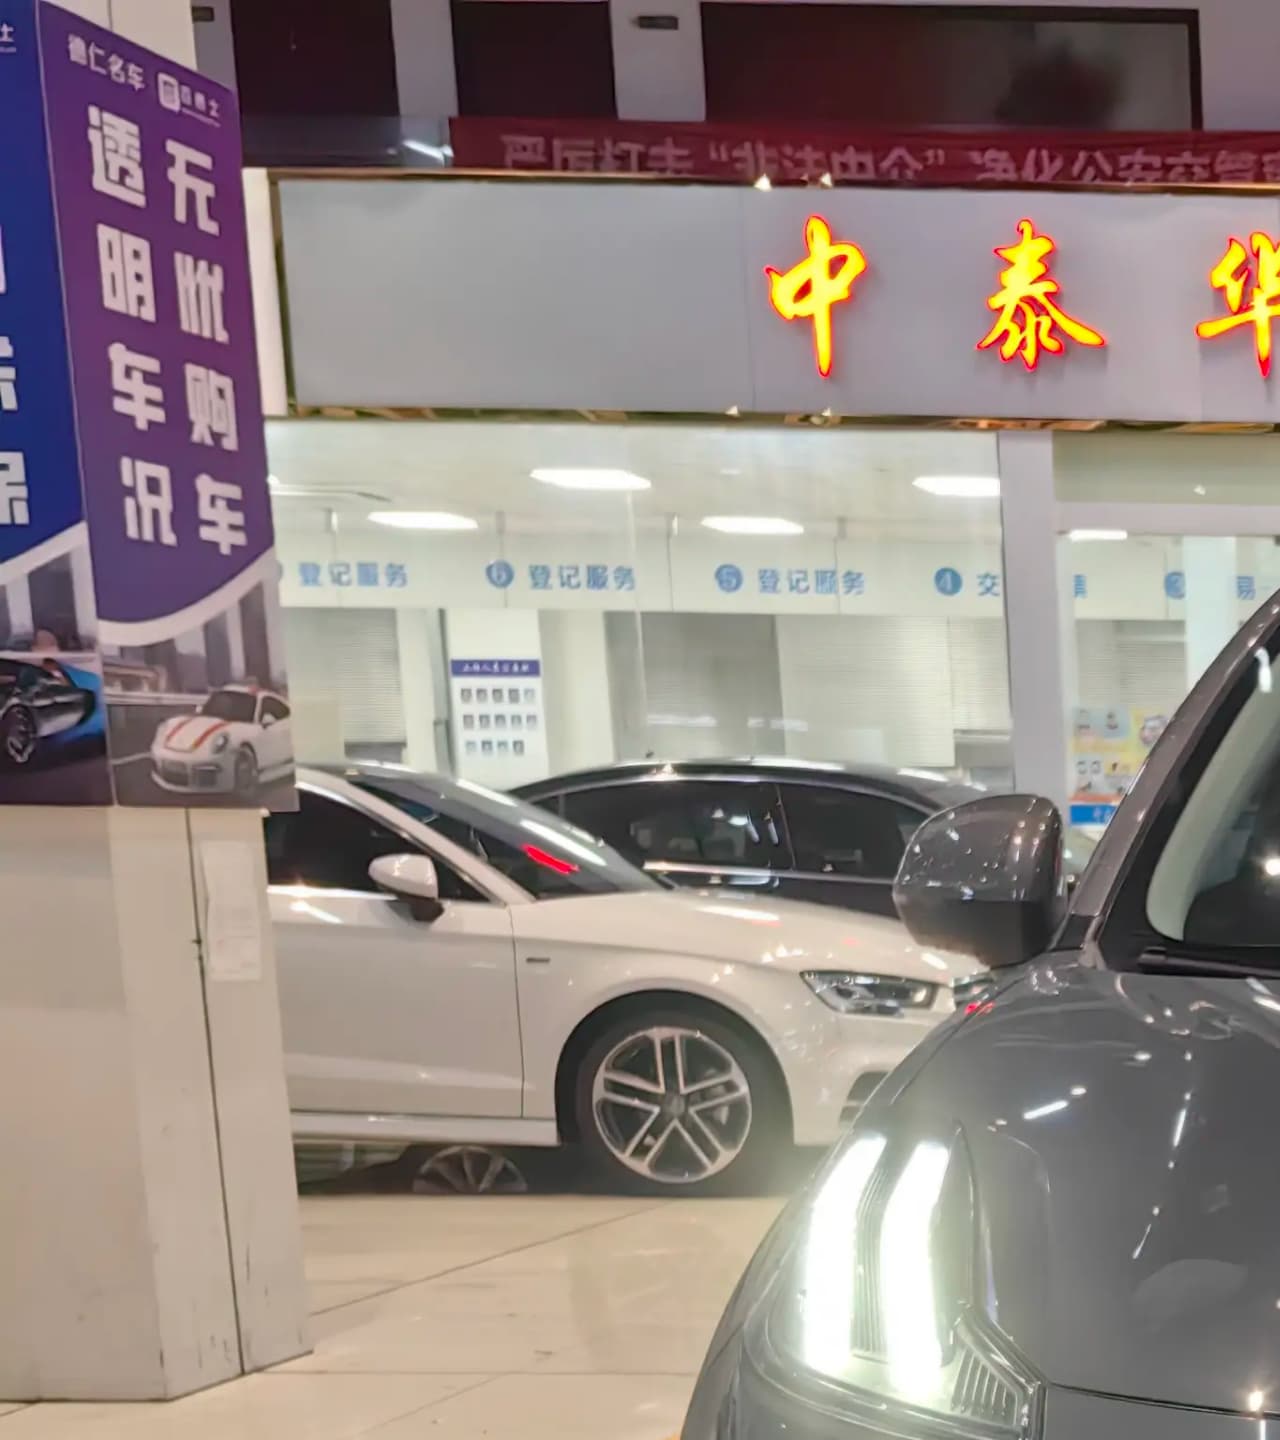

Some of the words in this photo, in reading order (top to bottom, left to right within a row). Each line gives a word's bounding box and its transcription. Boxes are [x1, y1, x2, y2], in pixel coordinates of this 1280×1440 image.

[87, 103, 177, 547] 透明车况
[165, 138, 249, 556] 无忧购车
